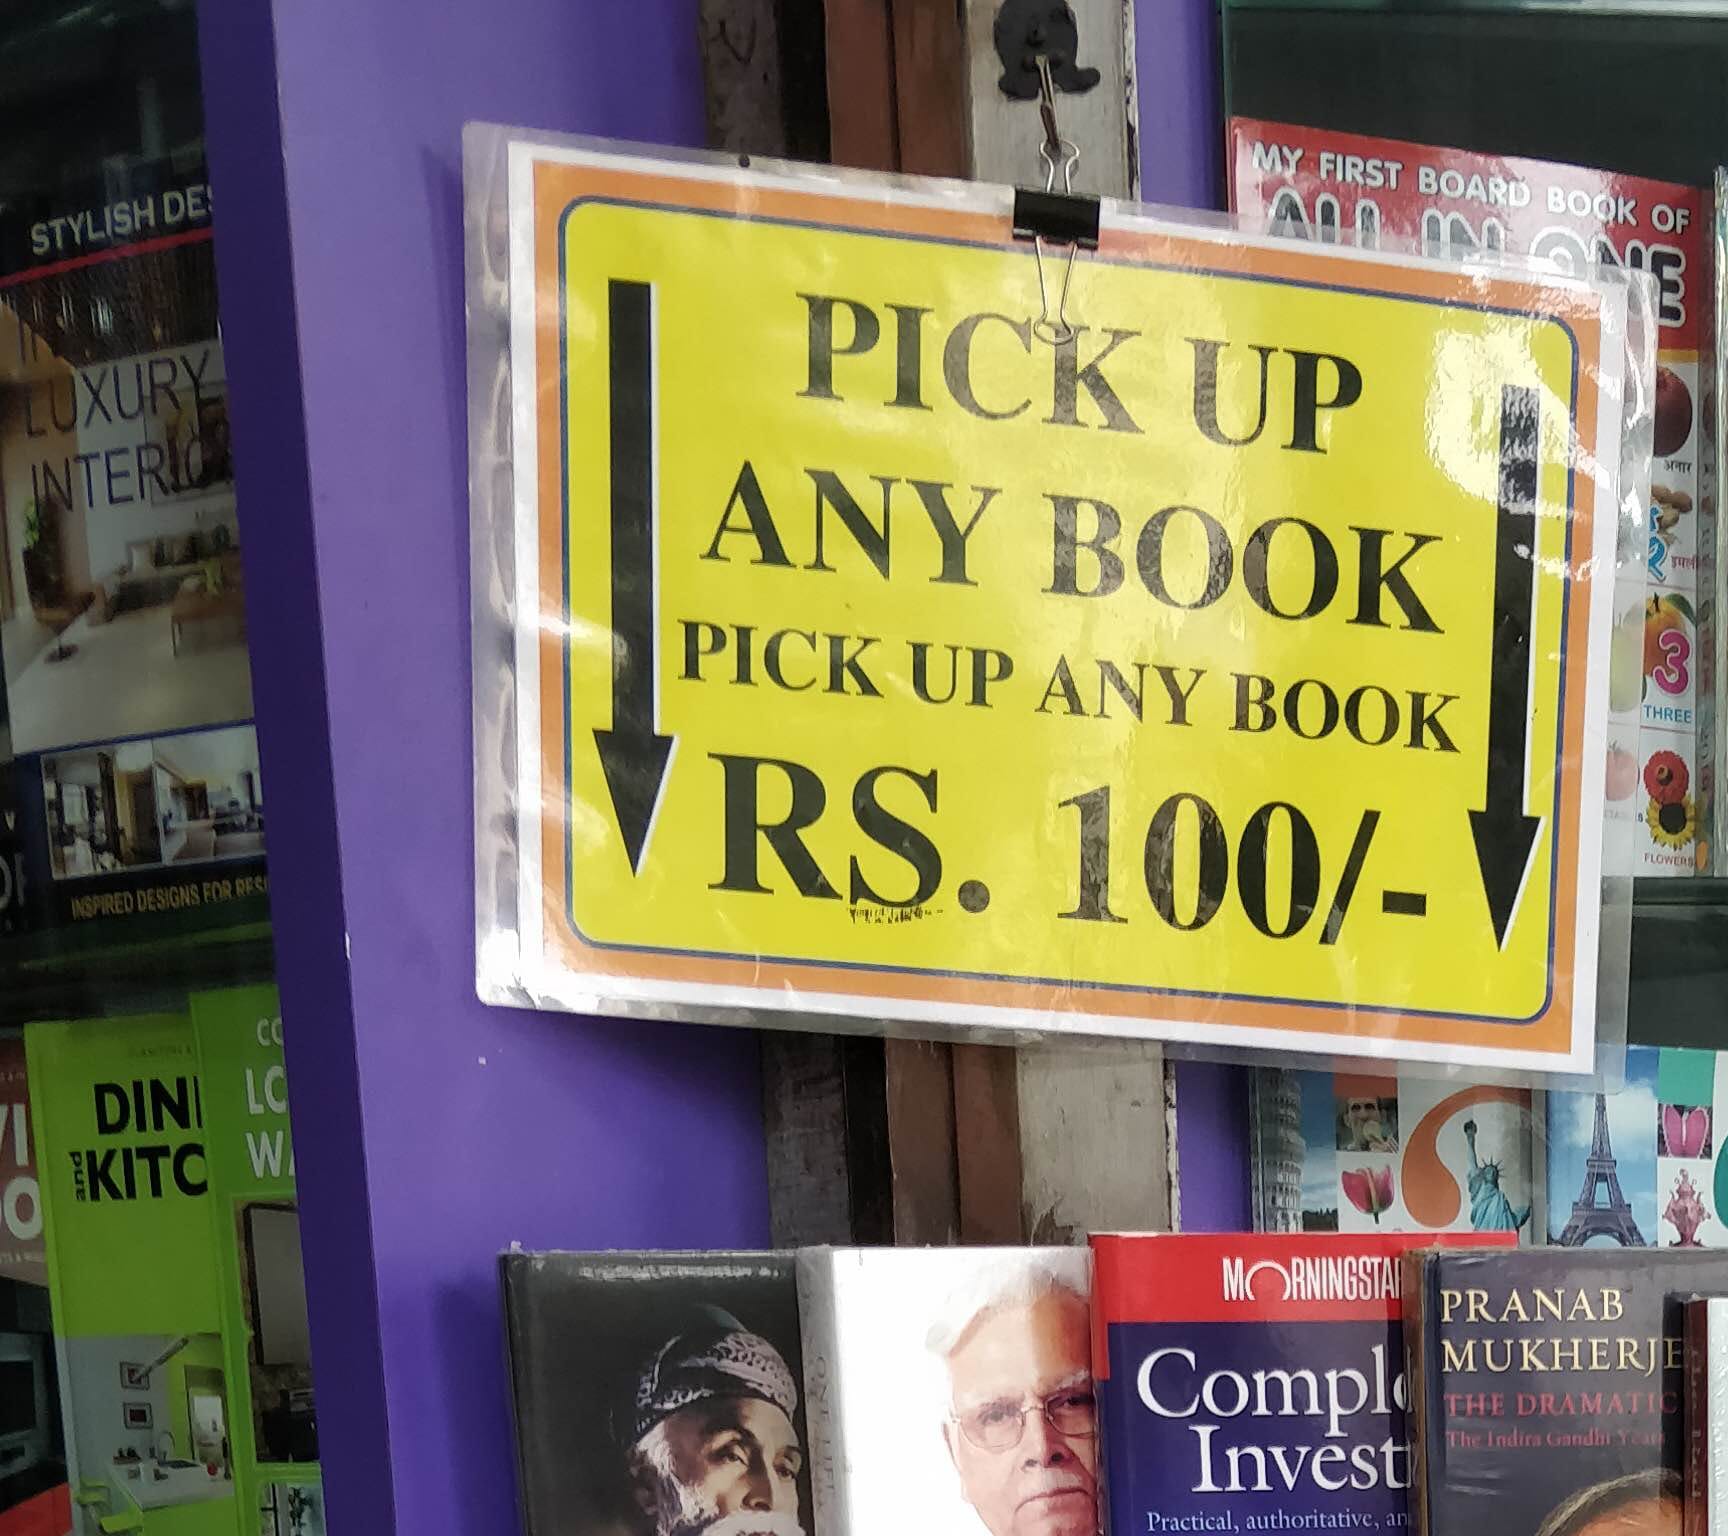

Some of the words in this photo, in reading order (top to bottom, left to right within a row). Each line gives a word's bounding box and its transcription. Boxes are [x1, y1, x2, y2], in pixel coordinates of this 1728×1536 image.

[30, 195, 155, 258] STYLISH
[1251, 141, 1302, 171] MY
[1319, 152, 1404, 189] FIRST
[1419, 166, 1530, 209] BOARD
[1547, 185, 1636, 227] BOOK
[1650, 207, 1690, 235] OF
[25, 350, 209, 441] LUXURY
[797, 291, 1145, 437] PICK
[1188, 337, 1362, 456] UP
[700, 461, 1002, 587] ANY
[1041, 495, 1448, 637] BOOK
[677, 618, 886, 698] PICK
[908, 640, 1015, 712] UP
[1035, 658, 1204, 727] ANY
[1232, 672, 1463, 754] BOOK
[1644, 703, 1692, 724] THREE
[706, 752, 990, 915] RS.
[1055, 784, 1428, 947] 100/-
[1441, 1287, 1624, 1324] PRANAB
[1146, 1512, 1240, 1535] Practical,
[1246, 1509, 1381, 1533] authoritative,
